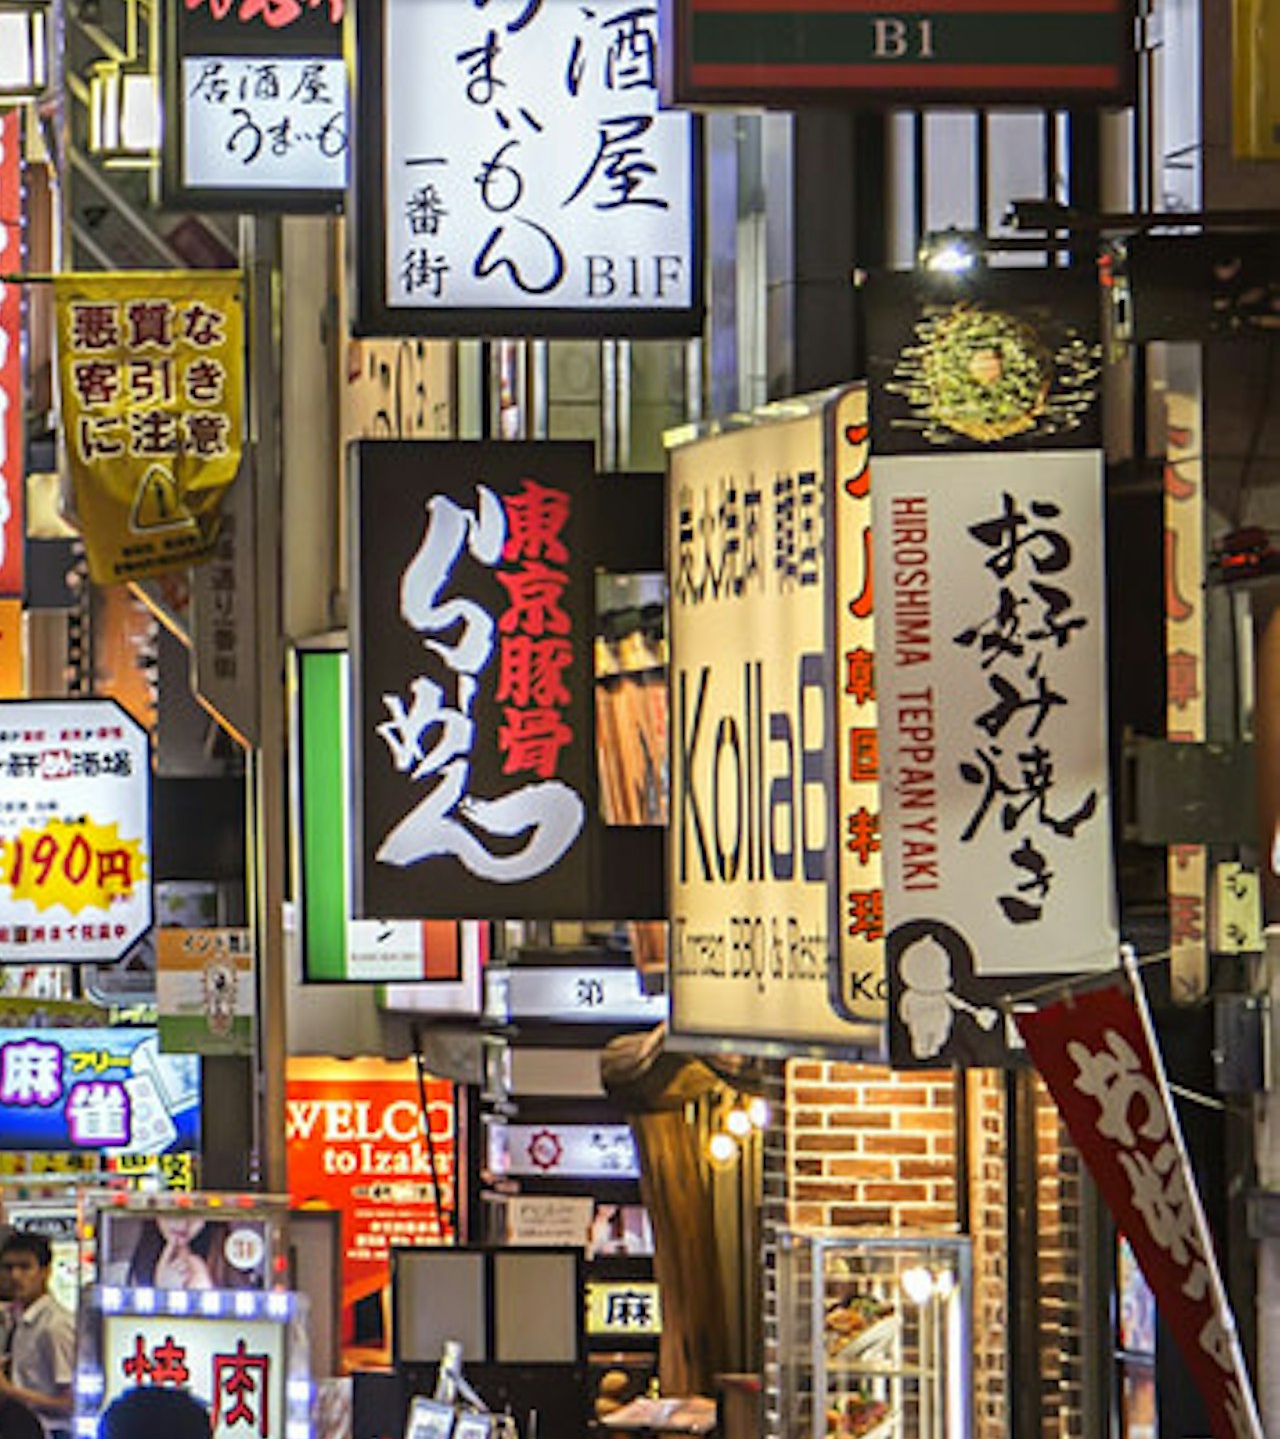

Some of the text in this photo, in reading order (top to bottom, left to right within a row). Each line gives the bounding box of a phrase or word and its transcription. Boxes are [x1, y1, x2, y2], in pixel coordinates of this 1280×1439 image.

[874, 19, 935, 55] B1
[192, 65, 332, 105] 居酒屋
[400, 157, 450, 297] 一番街
[582, 257, 684, 299] B1F
[72, 303, 224, 351] 悪質な
[72, 359, 228, 407] 客引き
[78, 414, 230, 461] に注意
[494, 477, 572, 779] 東京豚骨
[893, 497, 938, 893] HIROSHIMA TEPPANYAKI
[952, 493, 1098, 923] お好み焼き
[10, 834, 132, 889] 190円
